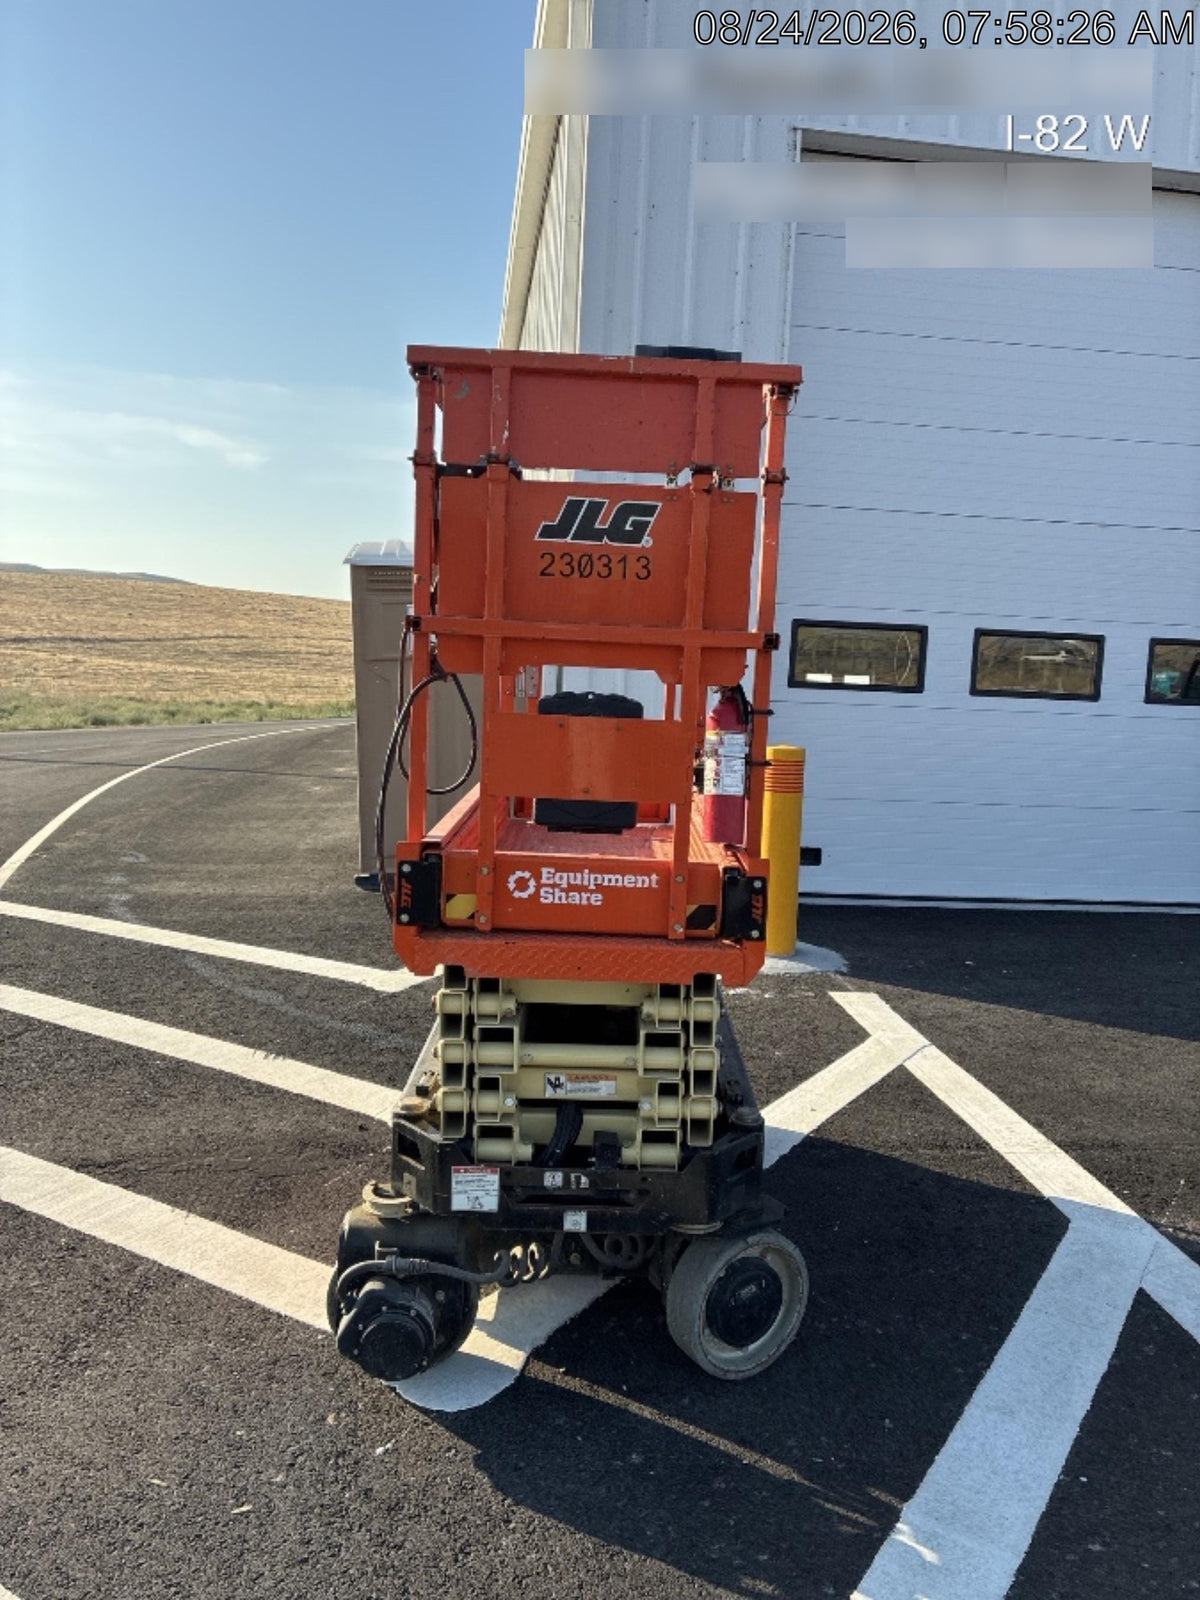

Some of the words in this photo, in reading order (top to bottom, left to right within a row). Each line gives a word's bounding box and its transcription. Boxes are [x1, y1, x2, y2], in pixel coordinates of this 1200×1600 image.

[535, 496, 662, 547] JLG
[539, 552, 651, 580] 230313
[540, 867, 659, 889] Equipment
[540, 887, 603, 905] Share
